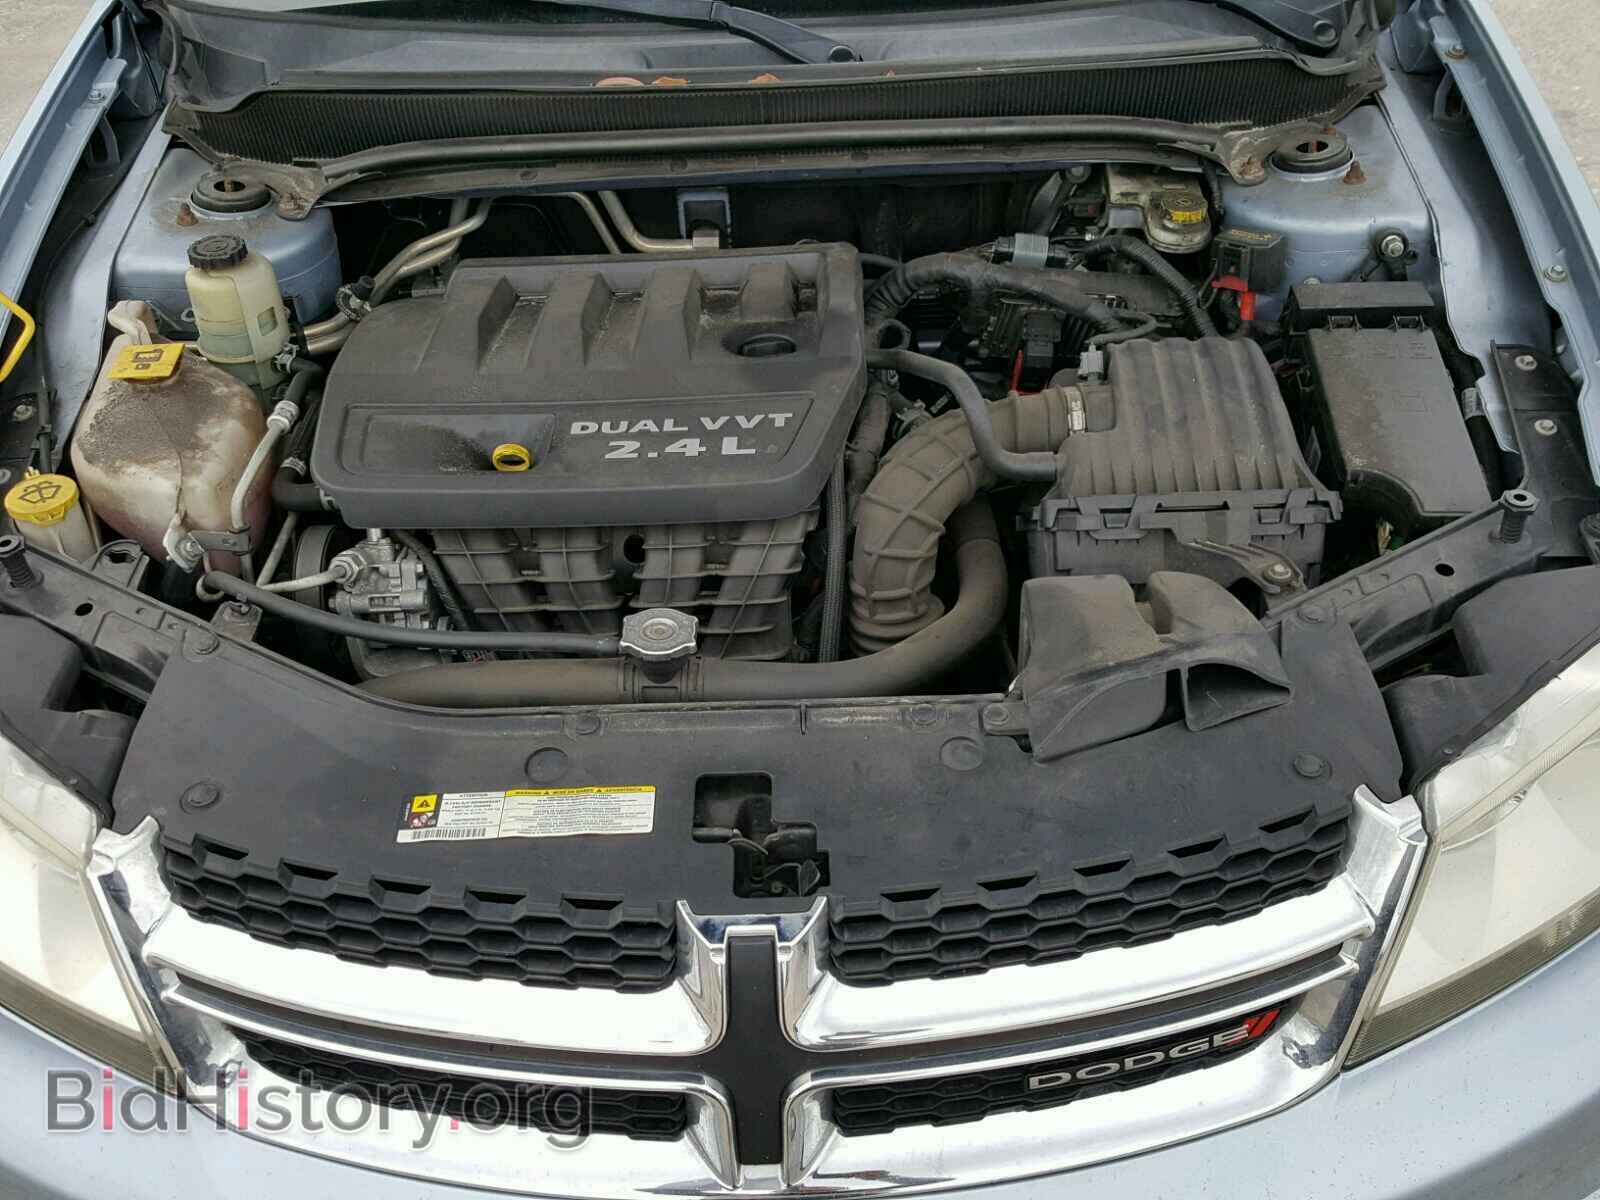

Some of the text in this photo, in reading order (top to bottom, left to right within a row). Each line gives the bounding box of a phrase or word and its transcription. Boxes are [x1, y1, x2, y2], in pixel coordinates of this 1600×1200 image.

[570, 412, 793, 435] DUAL VVT
[1028, 1024, 1250, 1090] DODGE
